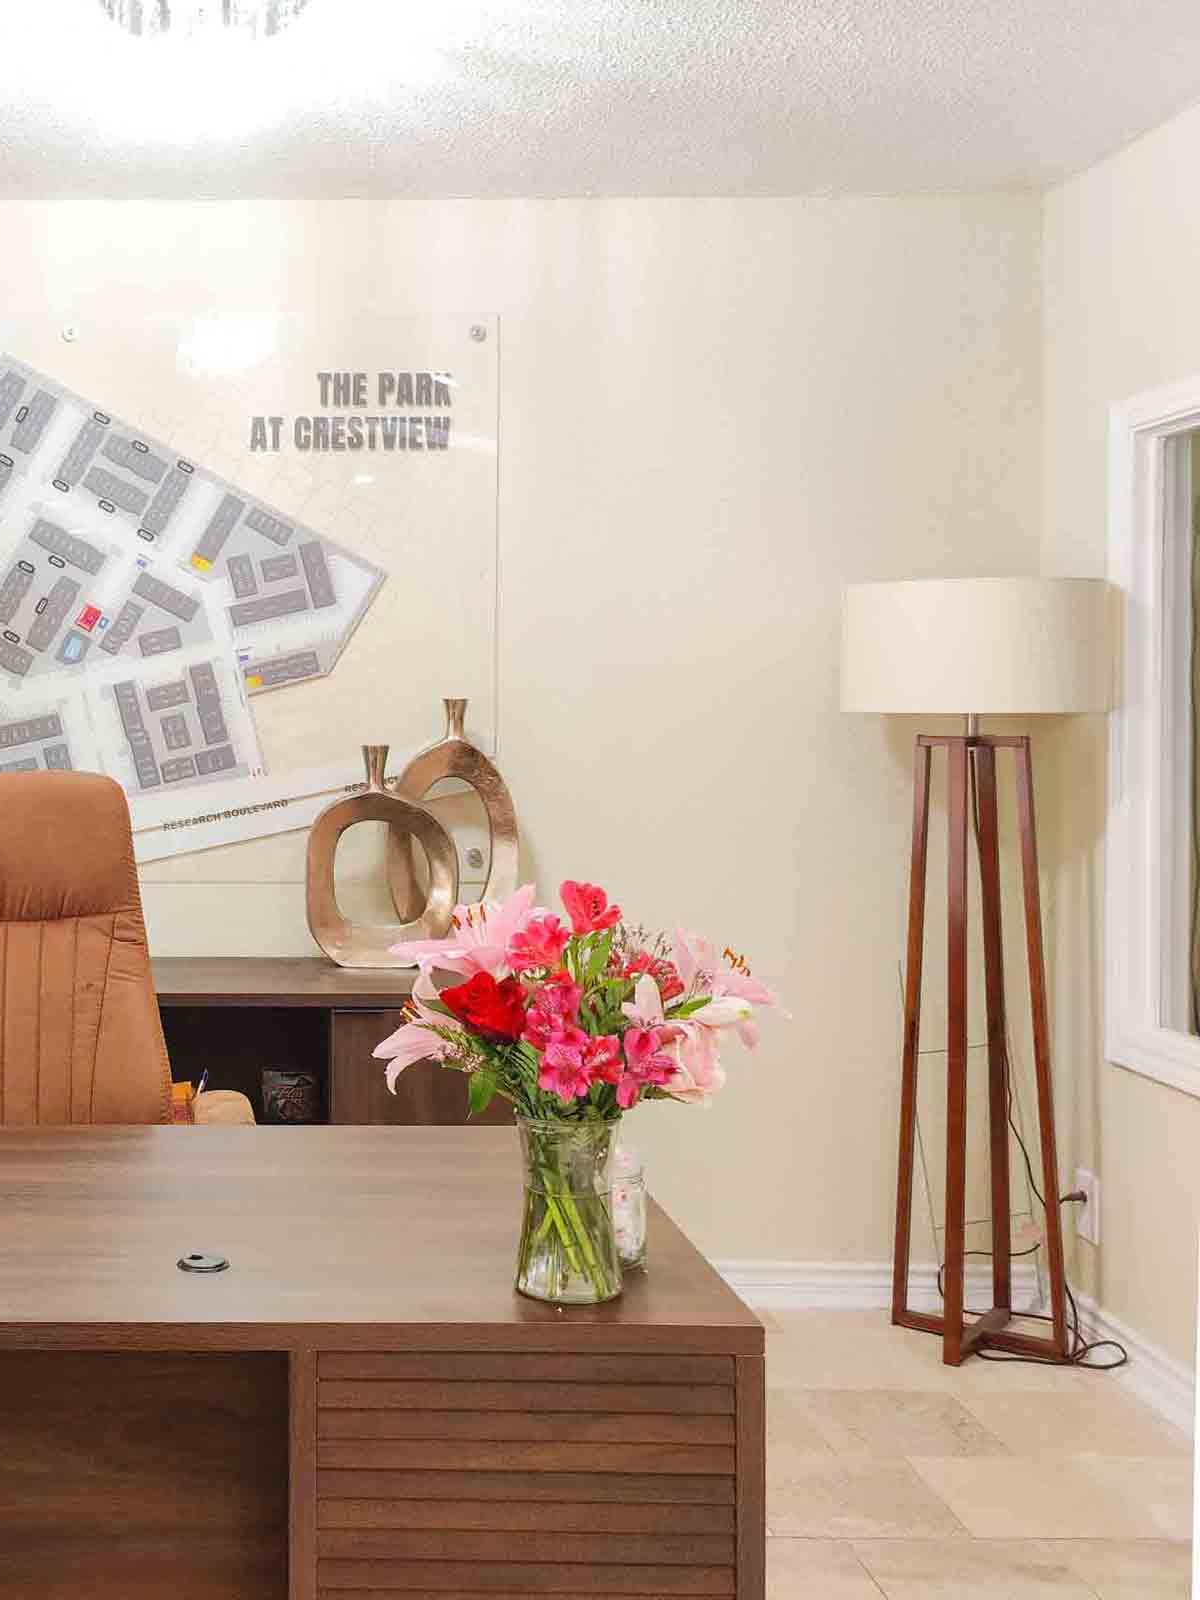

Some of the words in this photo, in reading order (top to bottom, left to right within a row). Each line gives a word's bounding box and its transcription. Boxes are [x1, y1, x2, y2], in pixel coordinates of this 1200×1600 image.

[318, 373, 367, 408] THE
[377, 373, 452, 408] PARK
[250, 417, 283, 452] AT
[294, 417, 451, 452] CRESTVIEW
[163, 813, 221, 831] RESEARCH
[224, 799, 289, 819] BOULEVARD
